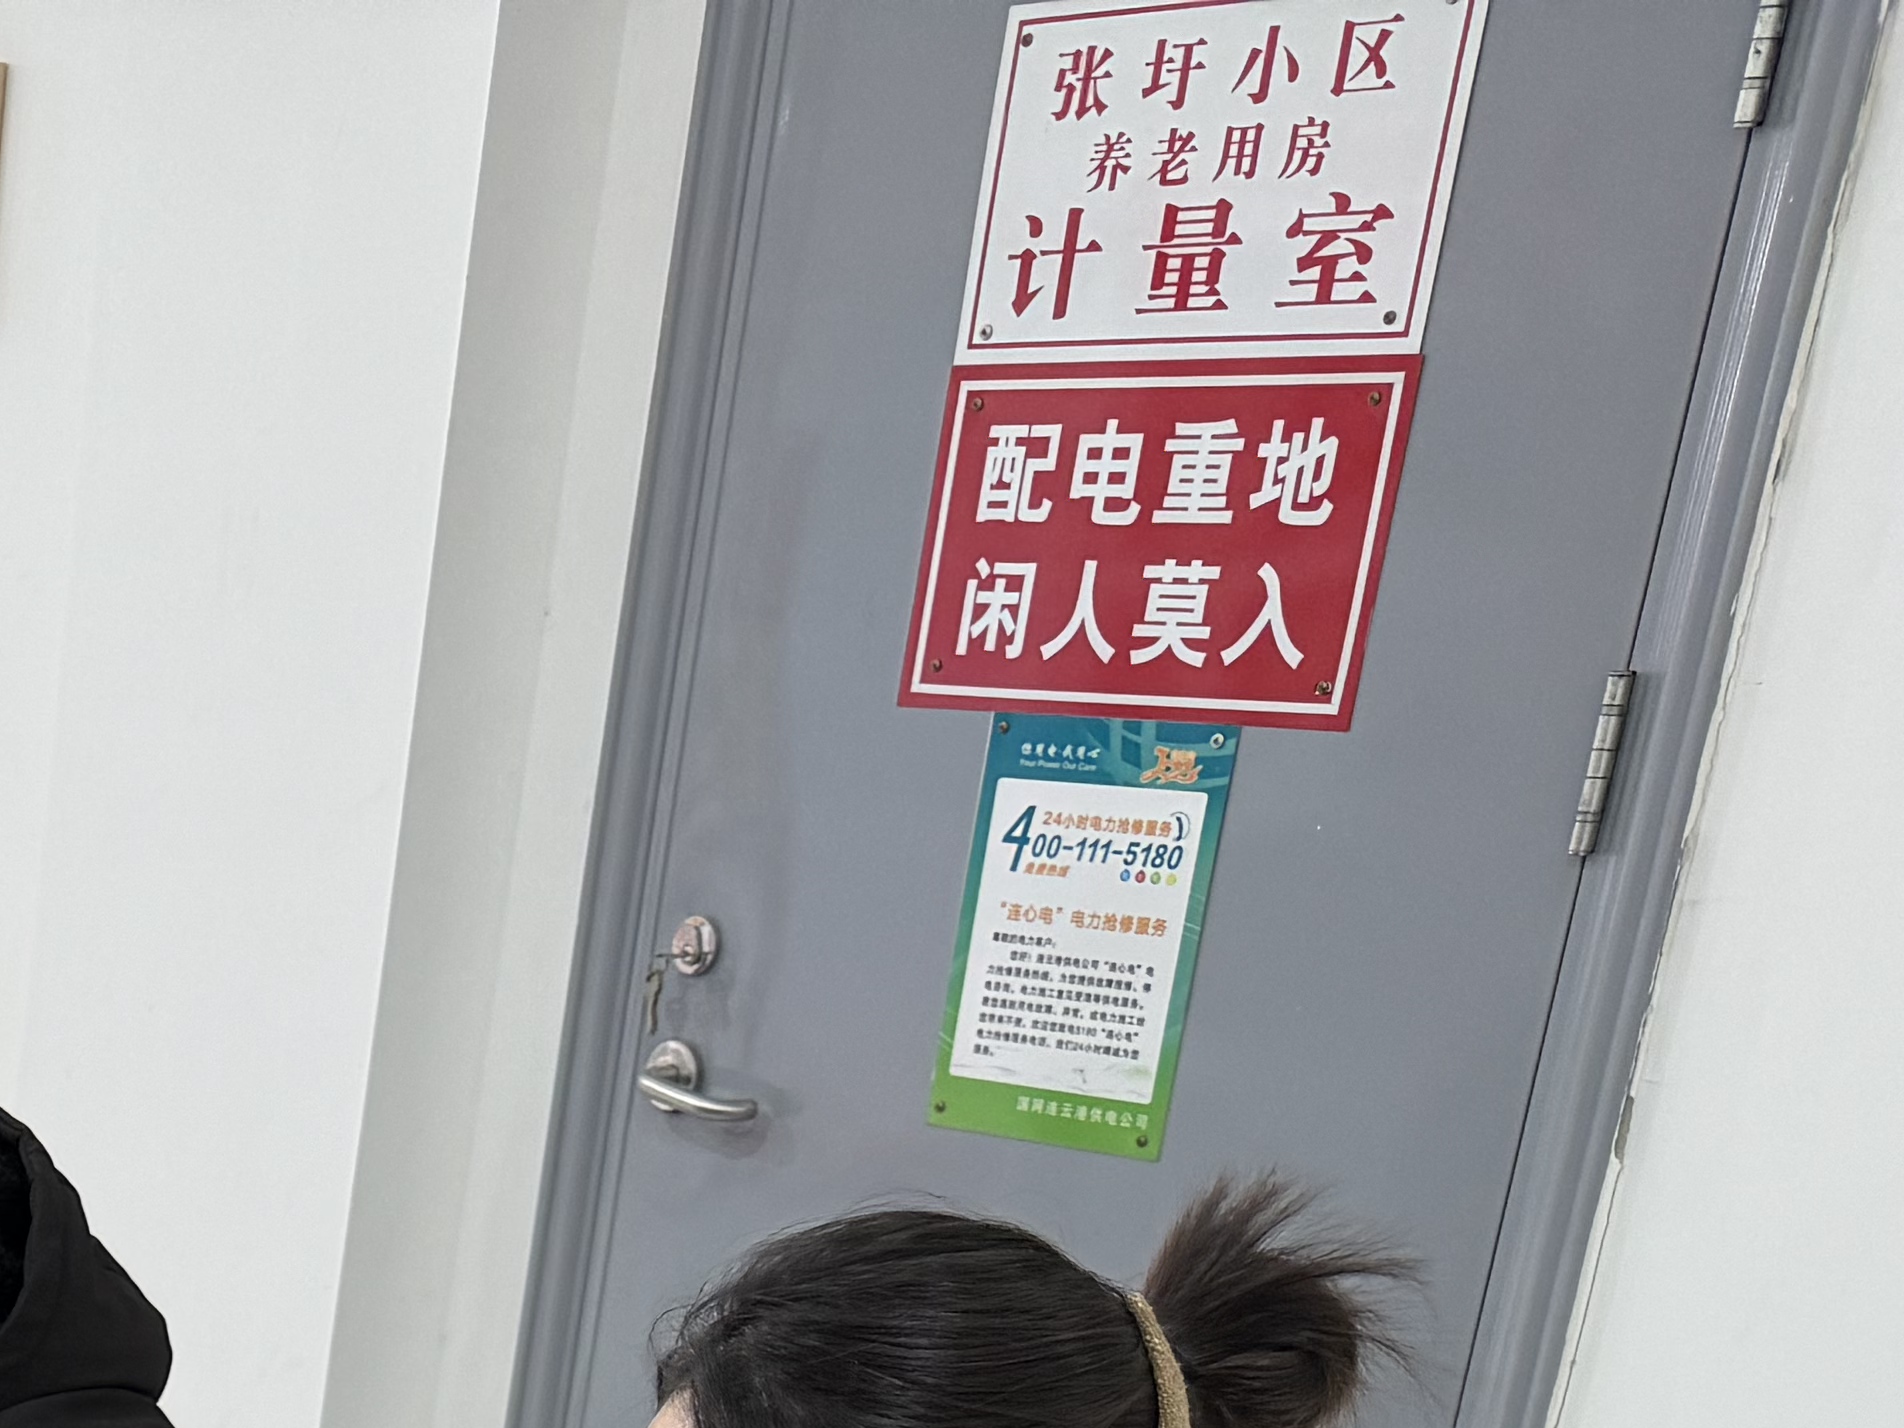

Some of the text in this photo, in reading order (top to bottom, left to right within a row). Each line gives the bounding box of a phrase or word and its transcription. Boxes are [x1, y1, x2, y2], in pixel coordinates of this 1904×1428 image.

[1051, 14, 1405, 122] 张圩小区
[1086, 116, 1332, 193] 养老用房
[1007, 192, 1395, 320] 计量室
[975, 417, 1340, 526] 配电重地
[954, 557, 1305, 670] 闲人莫入
